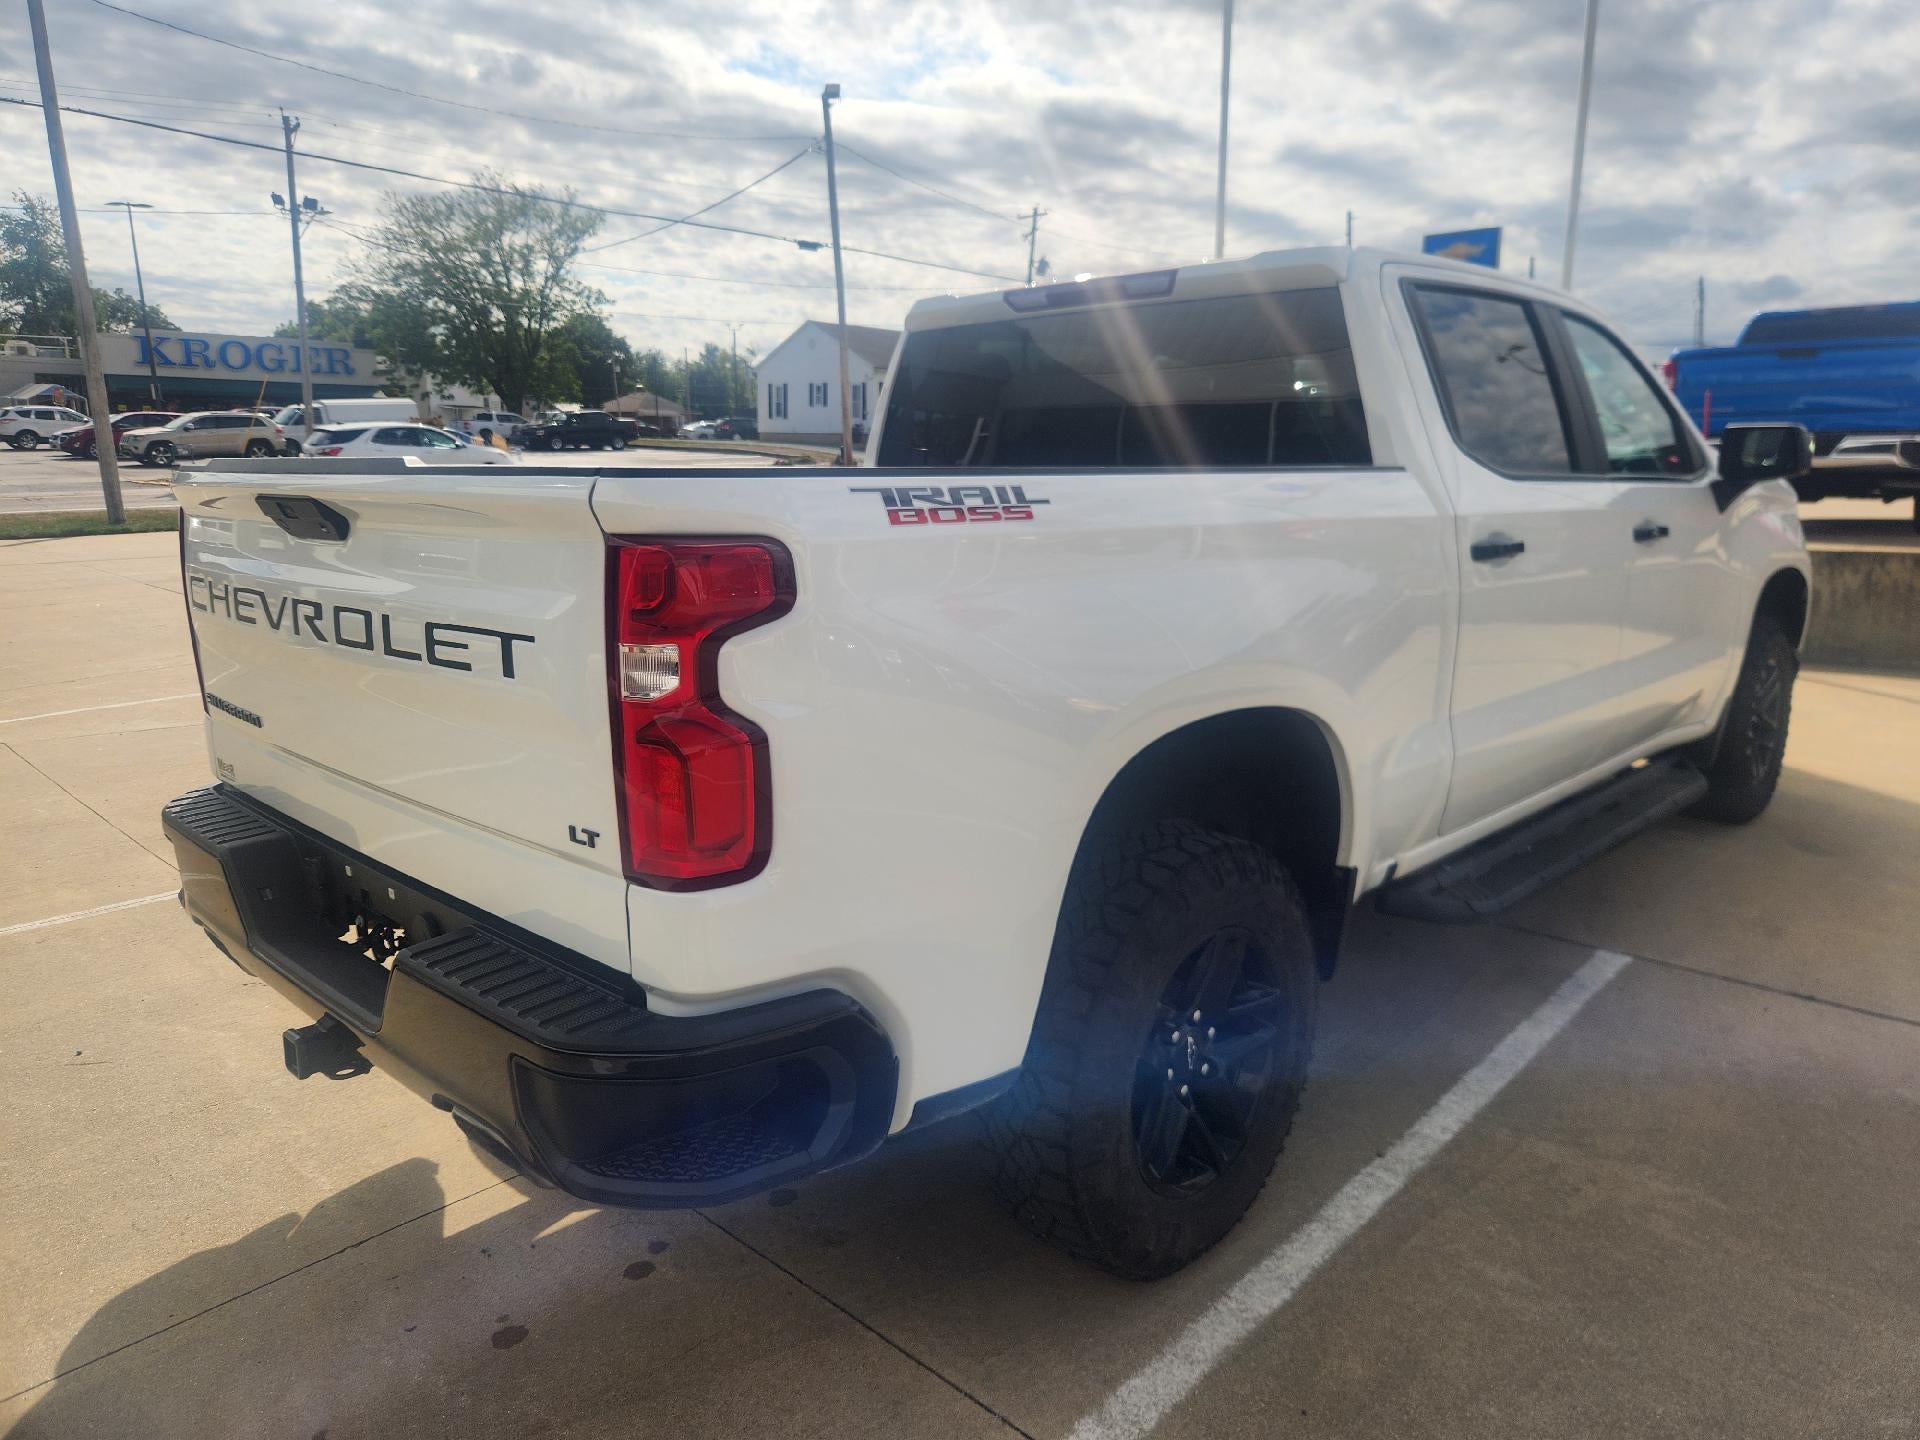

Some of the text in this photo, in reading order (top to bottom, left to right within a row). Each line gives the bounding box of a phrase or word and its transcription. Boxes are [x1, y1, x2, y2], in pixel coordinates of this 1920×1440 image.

[134, 335, 356, 376] KROGER
[850, 485, 1051, 507] TRAIL
[887, 506, 1034, 526] BOSS
[190, 575, 536, 679] CHEVROLET
[568, 824, 600, 848] LT
